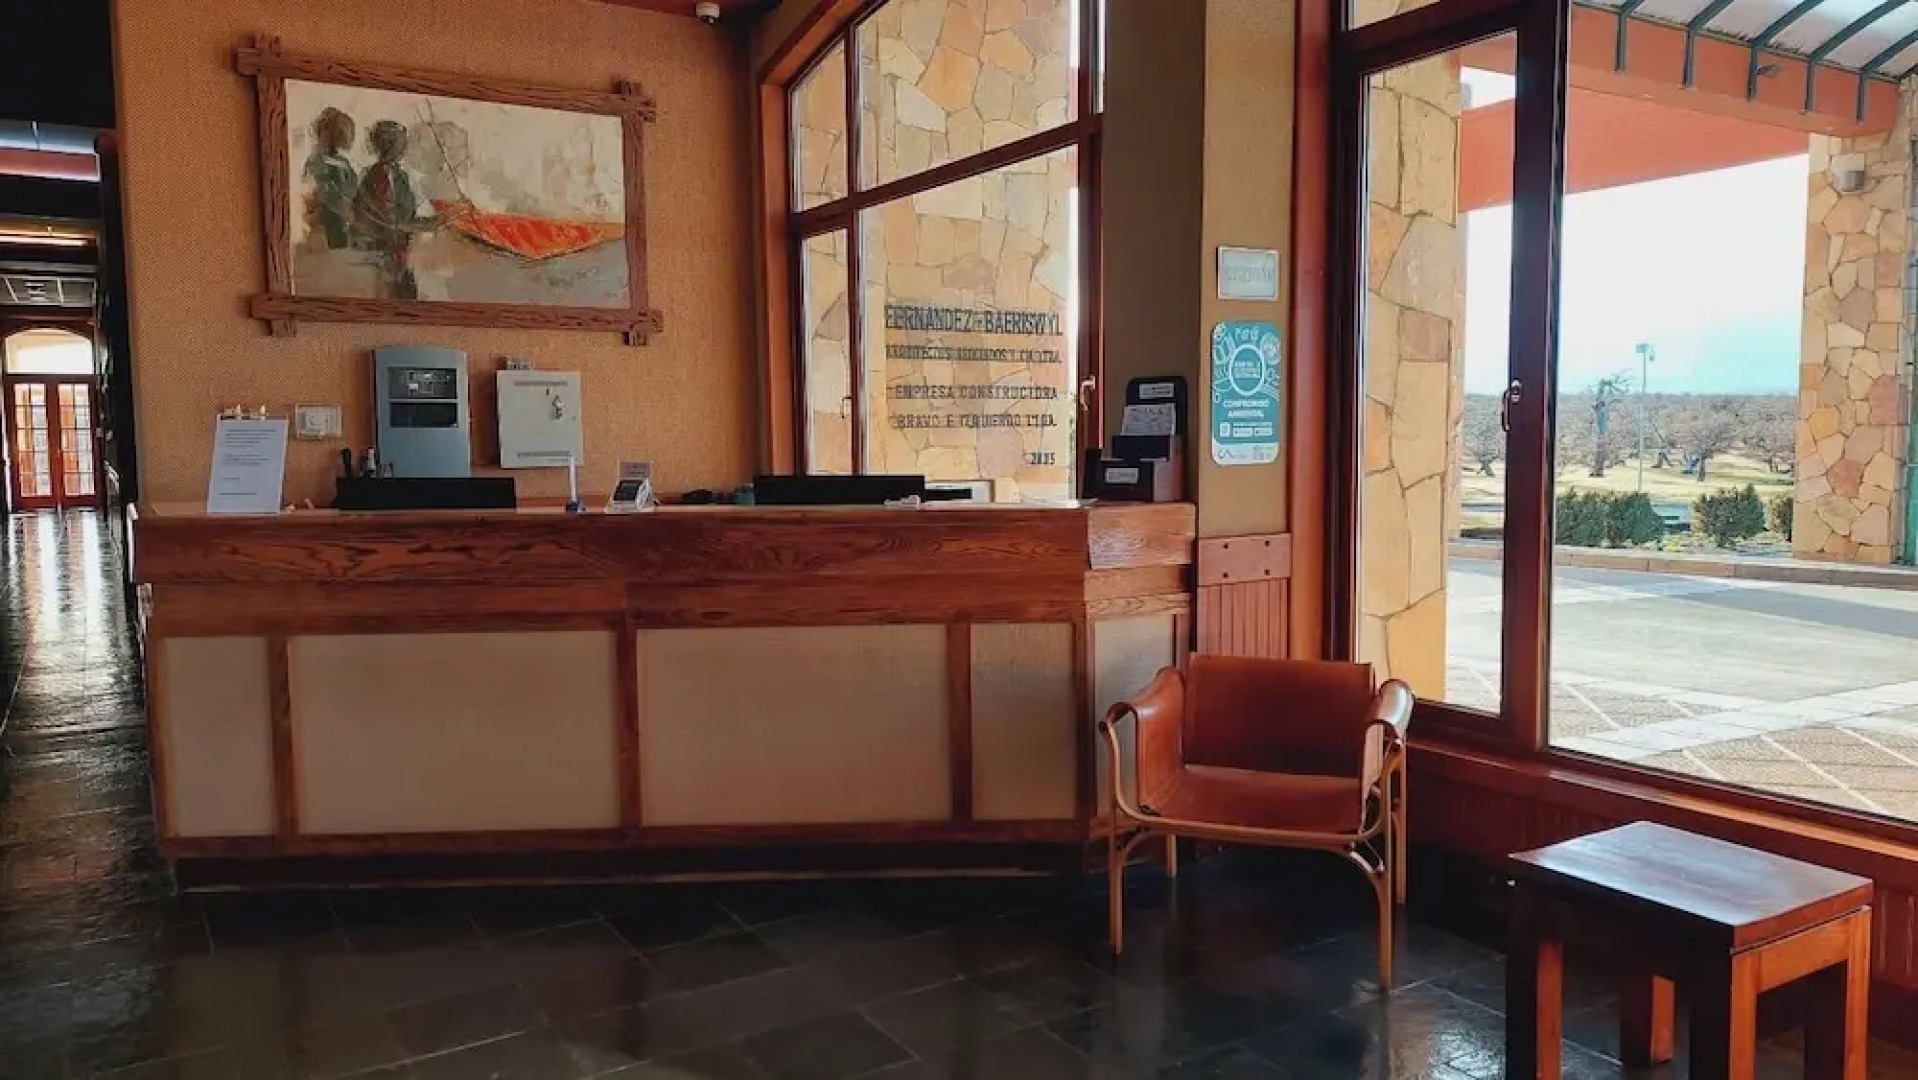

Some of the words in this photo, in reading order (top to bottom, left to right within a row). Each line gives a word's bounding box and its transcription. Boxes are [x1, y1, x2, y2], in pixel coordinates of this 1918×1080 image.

[896, 385, 955, 400] EMPRESA
[960, 386, 1058, 400] CONSTRUCTORA
[947, 414, 953, 428] E
